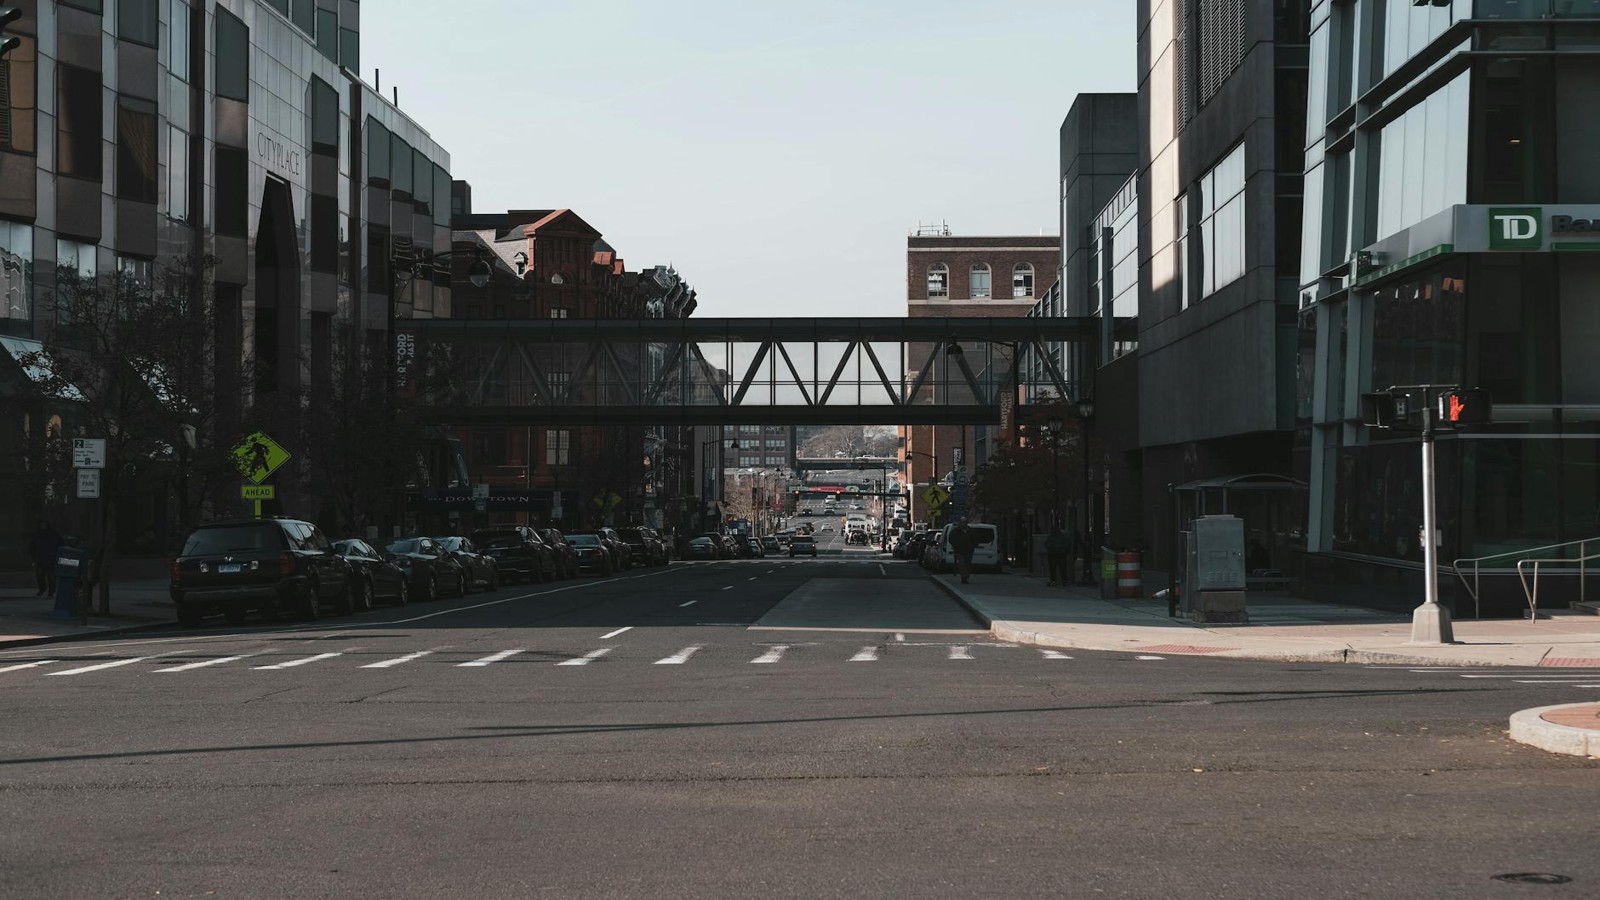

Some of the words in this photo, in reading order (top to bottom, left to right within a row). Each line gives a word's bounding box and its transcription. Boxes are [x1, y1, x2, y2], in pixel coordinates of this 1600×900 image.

[258, 132, 299, 175] CITYPLACE
[1493, 214, 1537, 240] TD
[1000, 392, 1008, 429] HARTFORD
[245, 488, 271, 497] AHEAD
[445, 495, 529, 503] DOWTOWN
